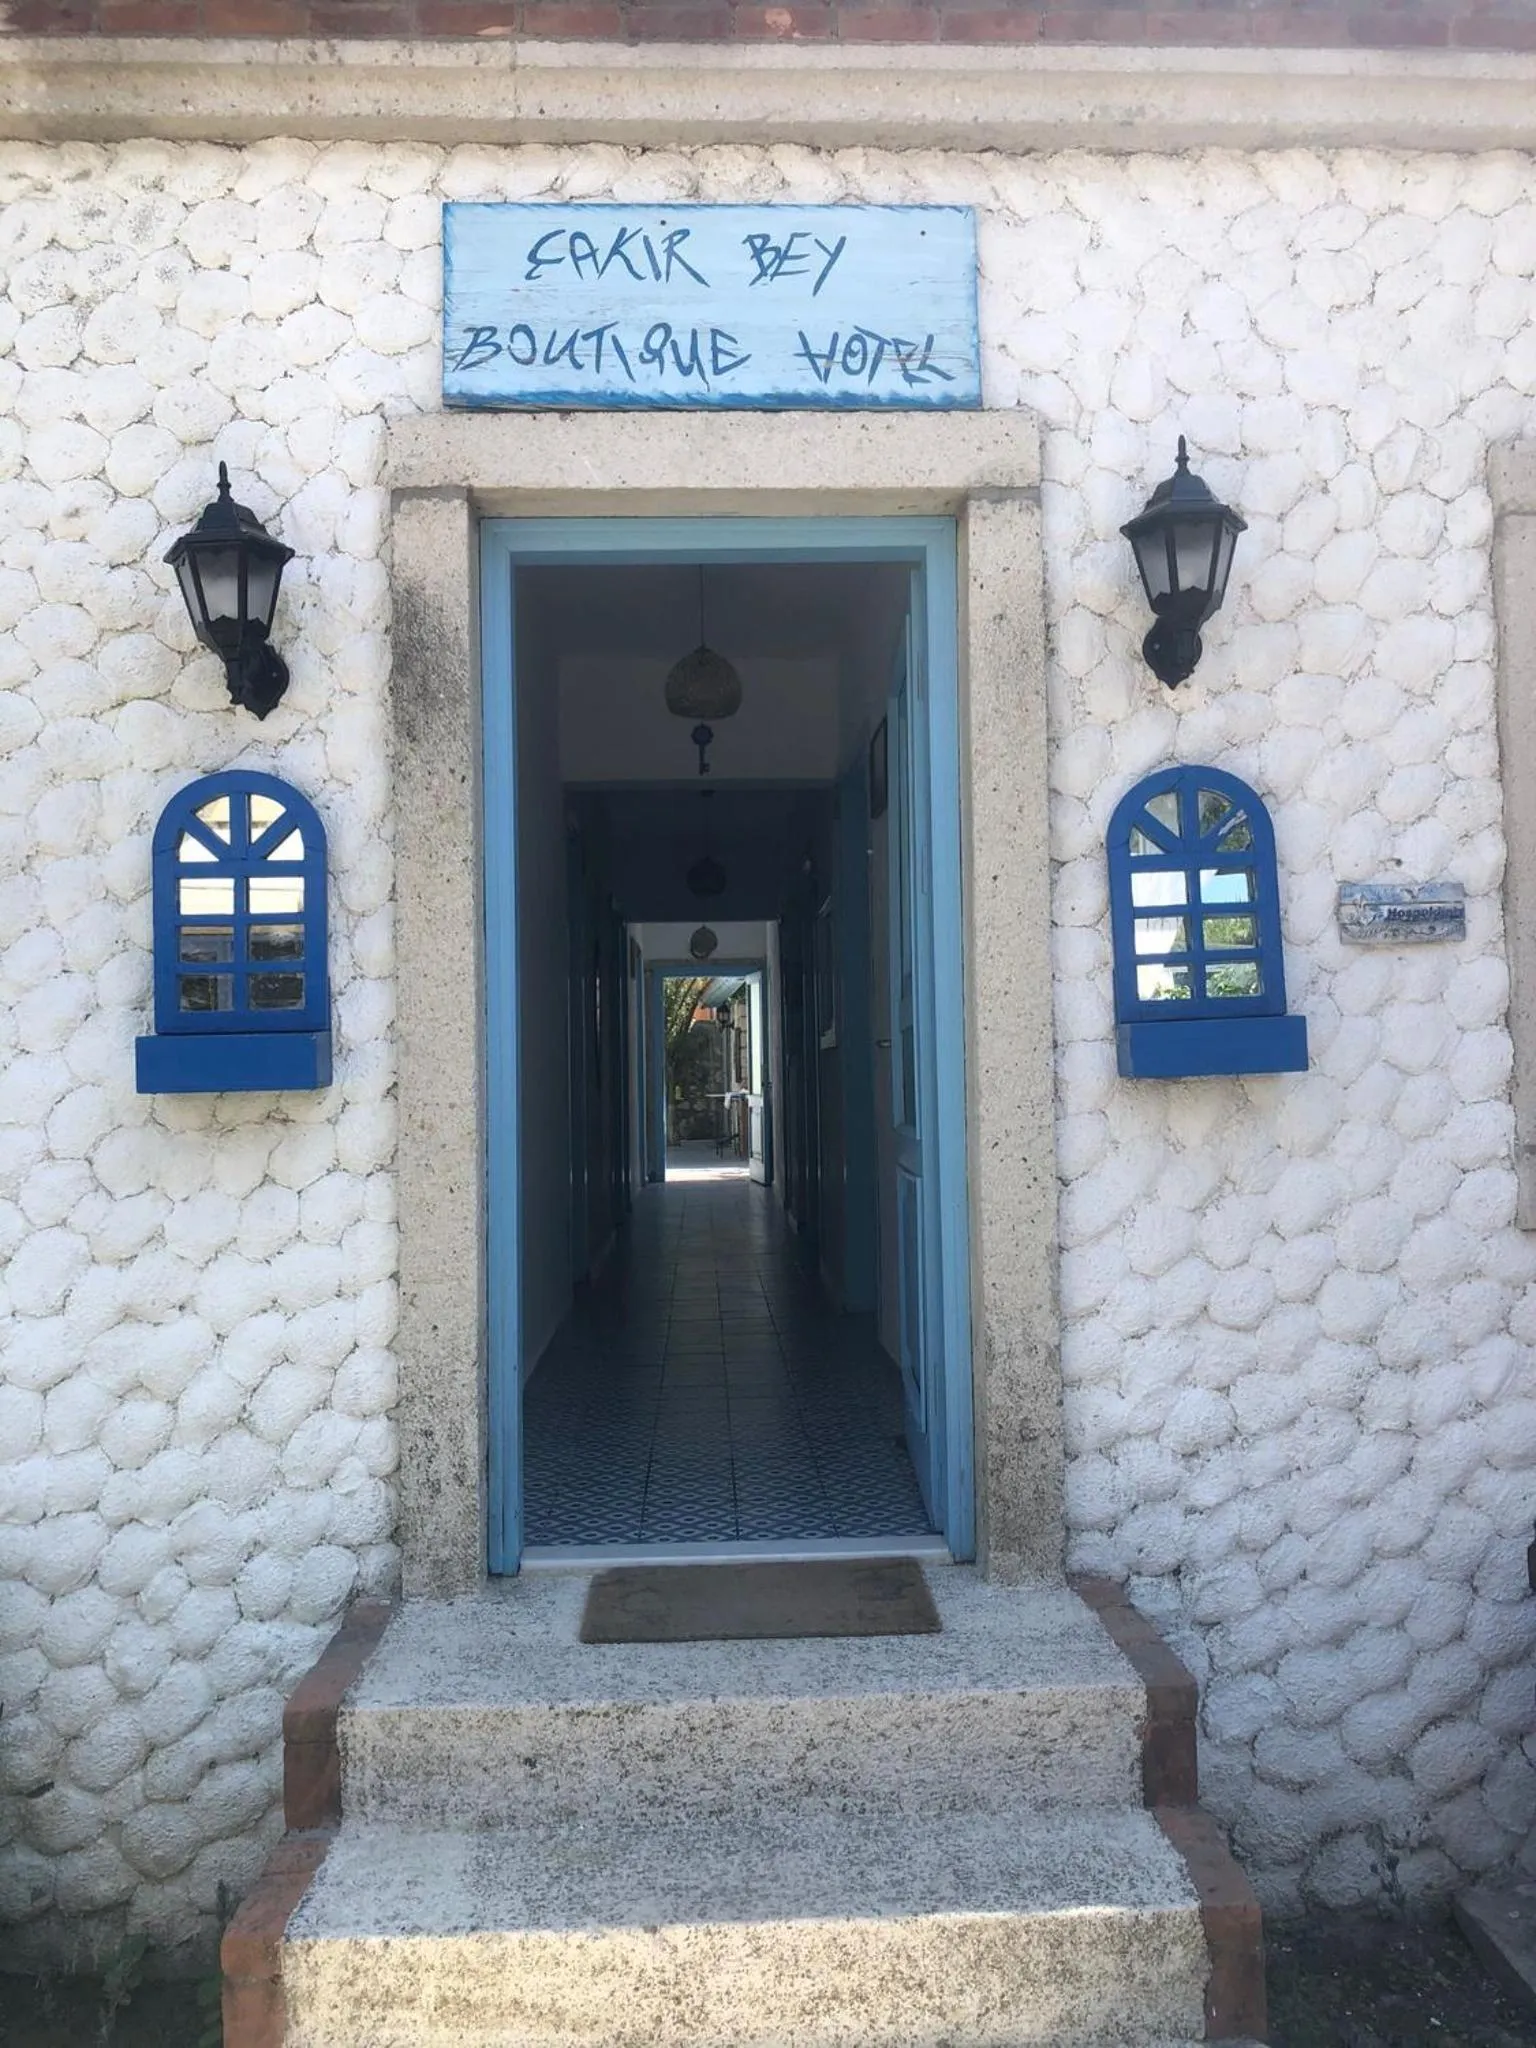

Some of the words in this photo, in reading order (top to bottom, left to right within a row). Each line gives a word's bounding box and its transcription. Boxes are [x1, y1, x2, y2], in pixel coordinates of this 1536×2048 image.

[742, 231, 848, 297] BEY
[452, 321, 752, 392] BOUTIQUE
[796, 324, 957, 386] HOTEL
